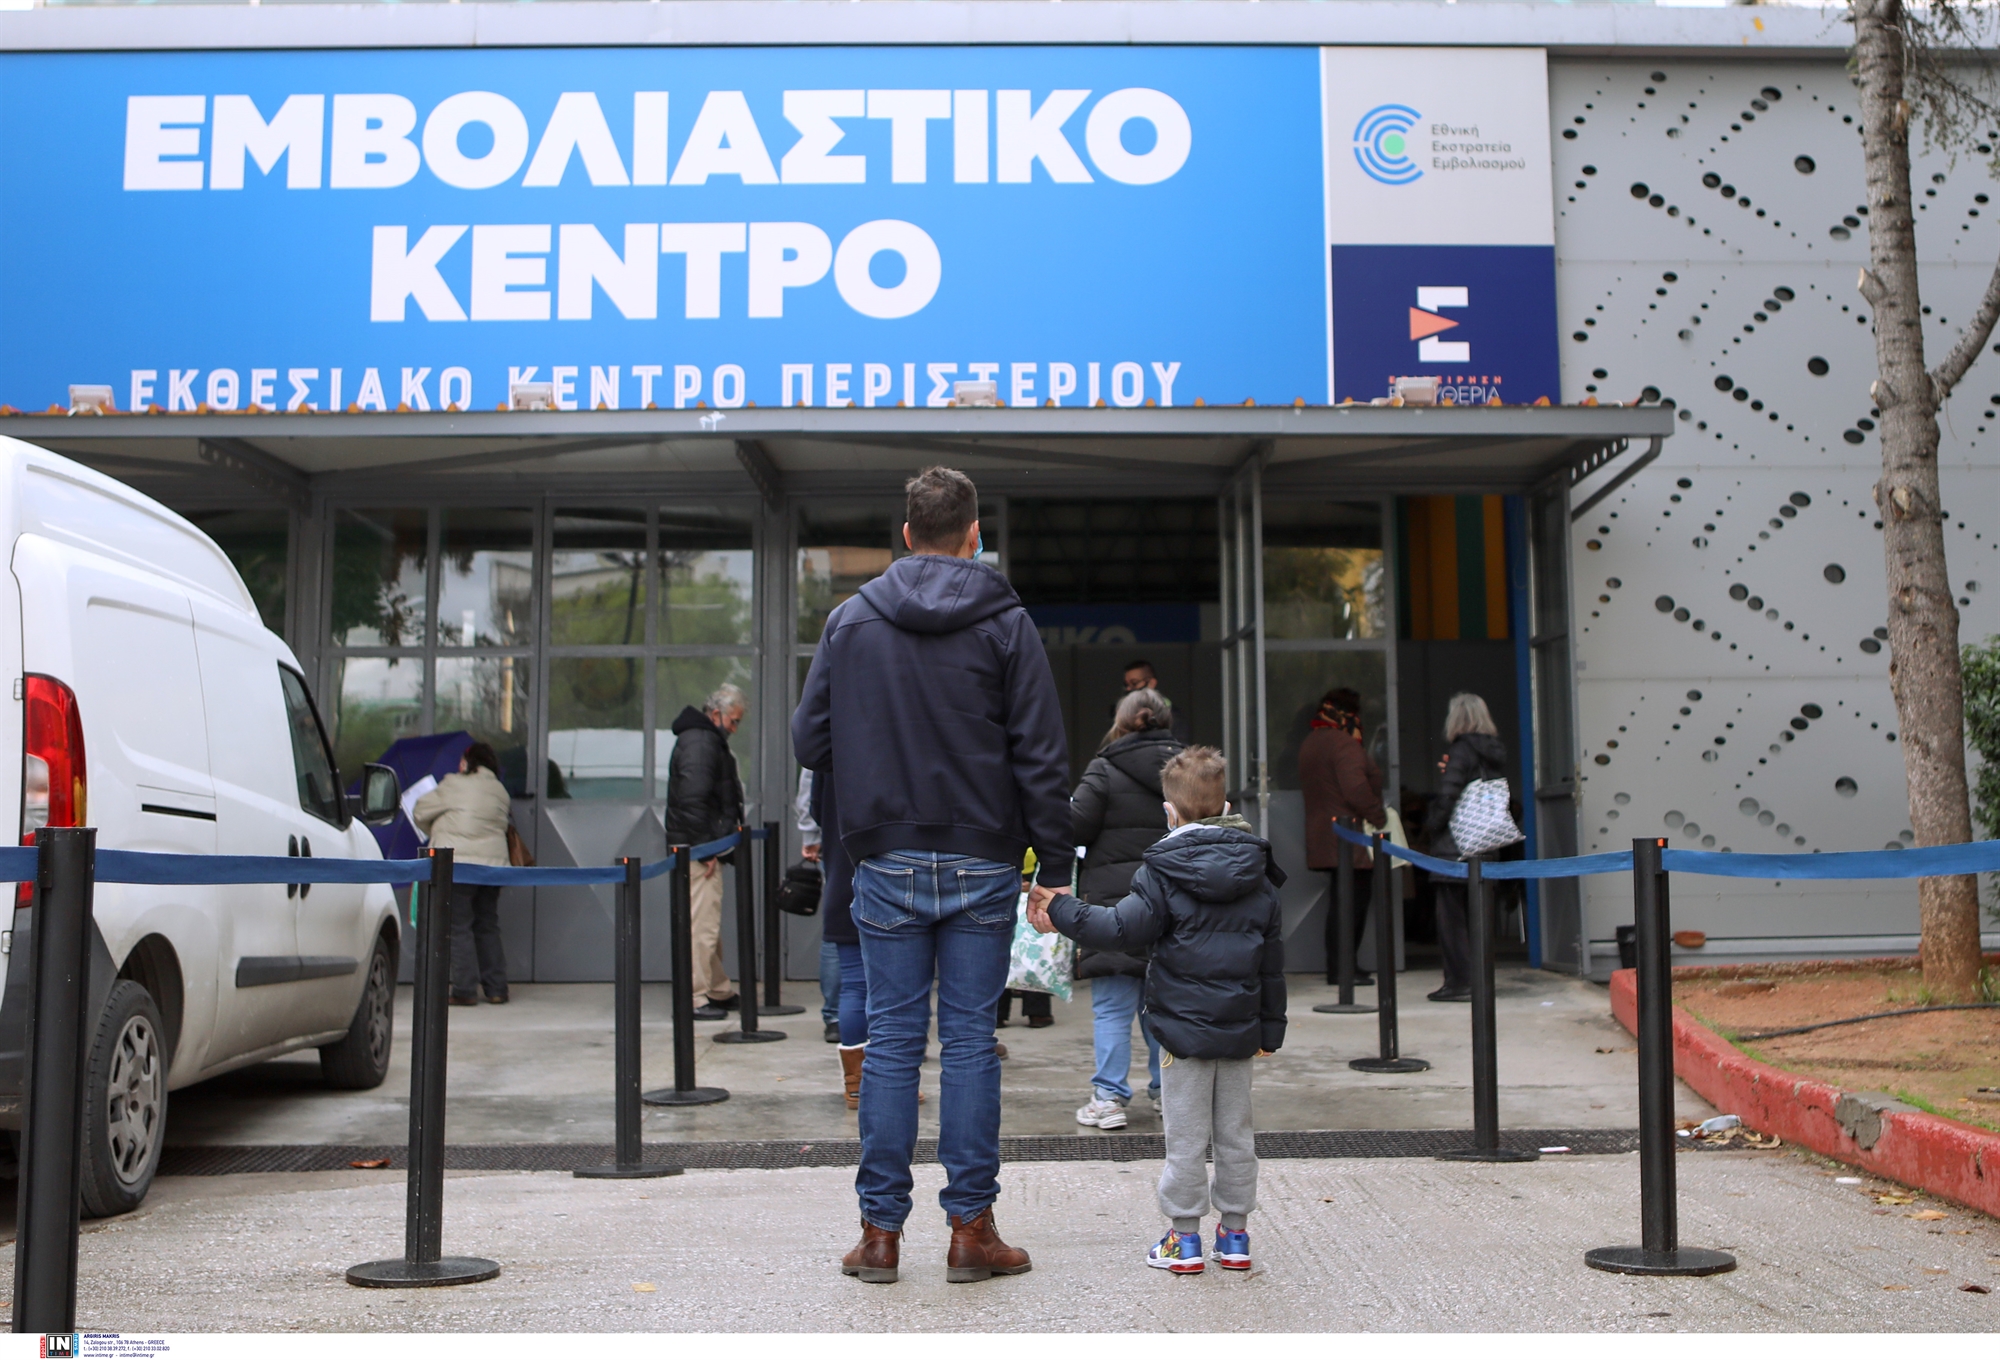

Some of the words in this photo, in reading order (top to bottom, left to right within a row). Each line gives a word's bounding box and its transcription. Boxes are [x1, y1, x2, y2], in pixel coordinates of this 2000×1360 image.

[123, 87, 1193, 191] ΕΜΒΟΛΙΑΣΤΙΚΟ
[1431, 123, 1480, 138] Εθνική
[1432, 140, 1512, 155] Εκστρατεία
[1432, 156, 1526, 171] Εμβολιασμού
[370, 219, 942, 322] ΚΕΝΤΡΟ
[130, 367, 472, 412] ΕΚΘΕΣΙΑΚΟ
